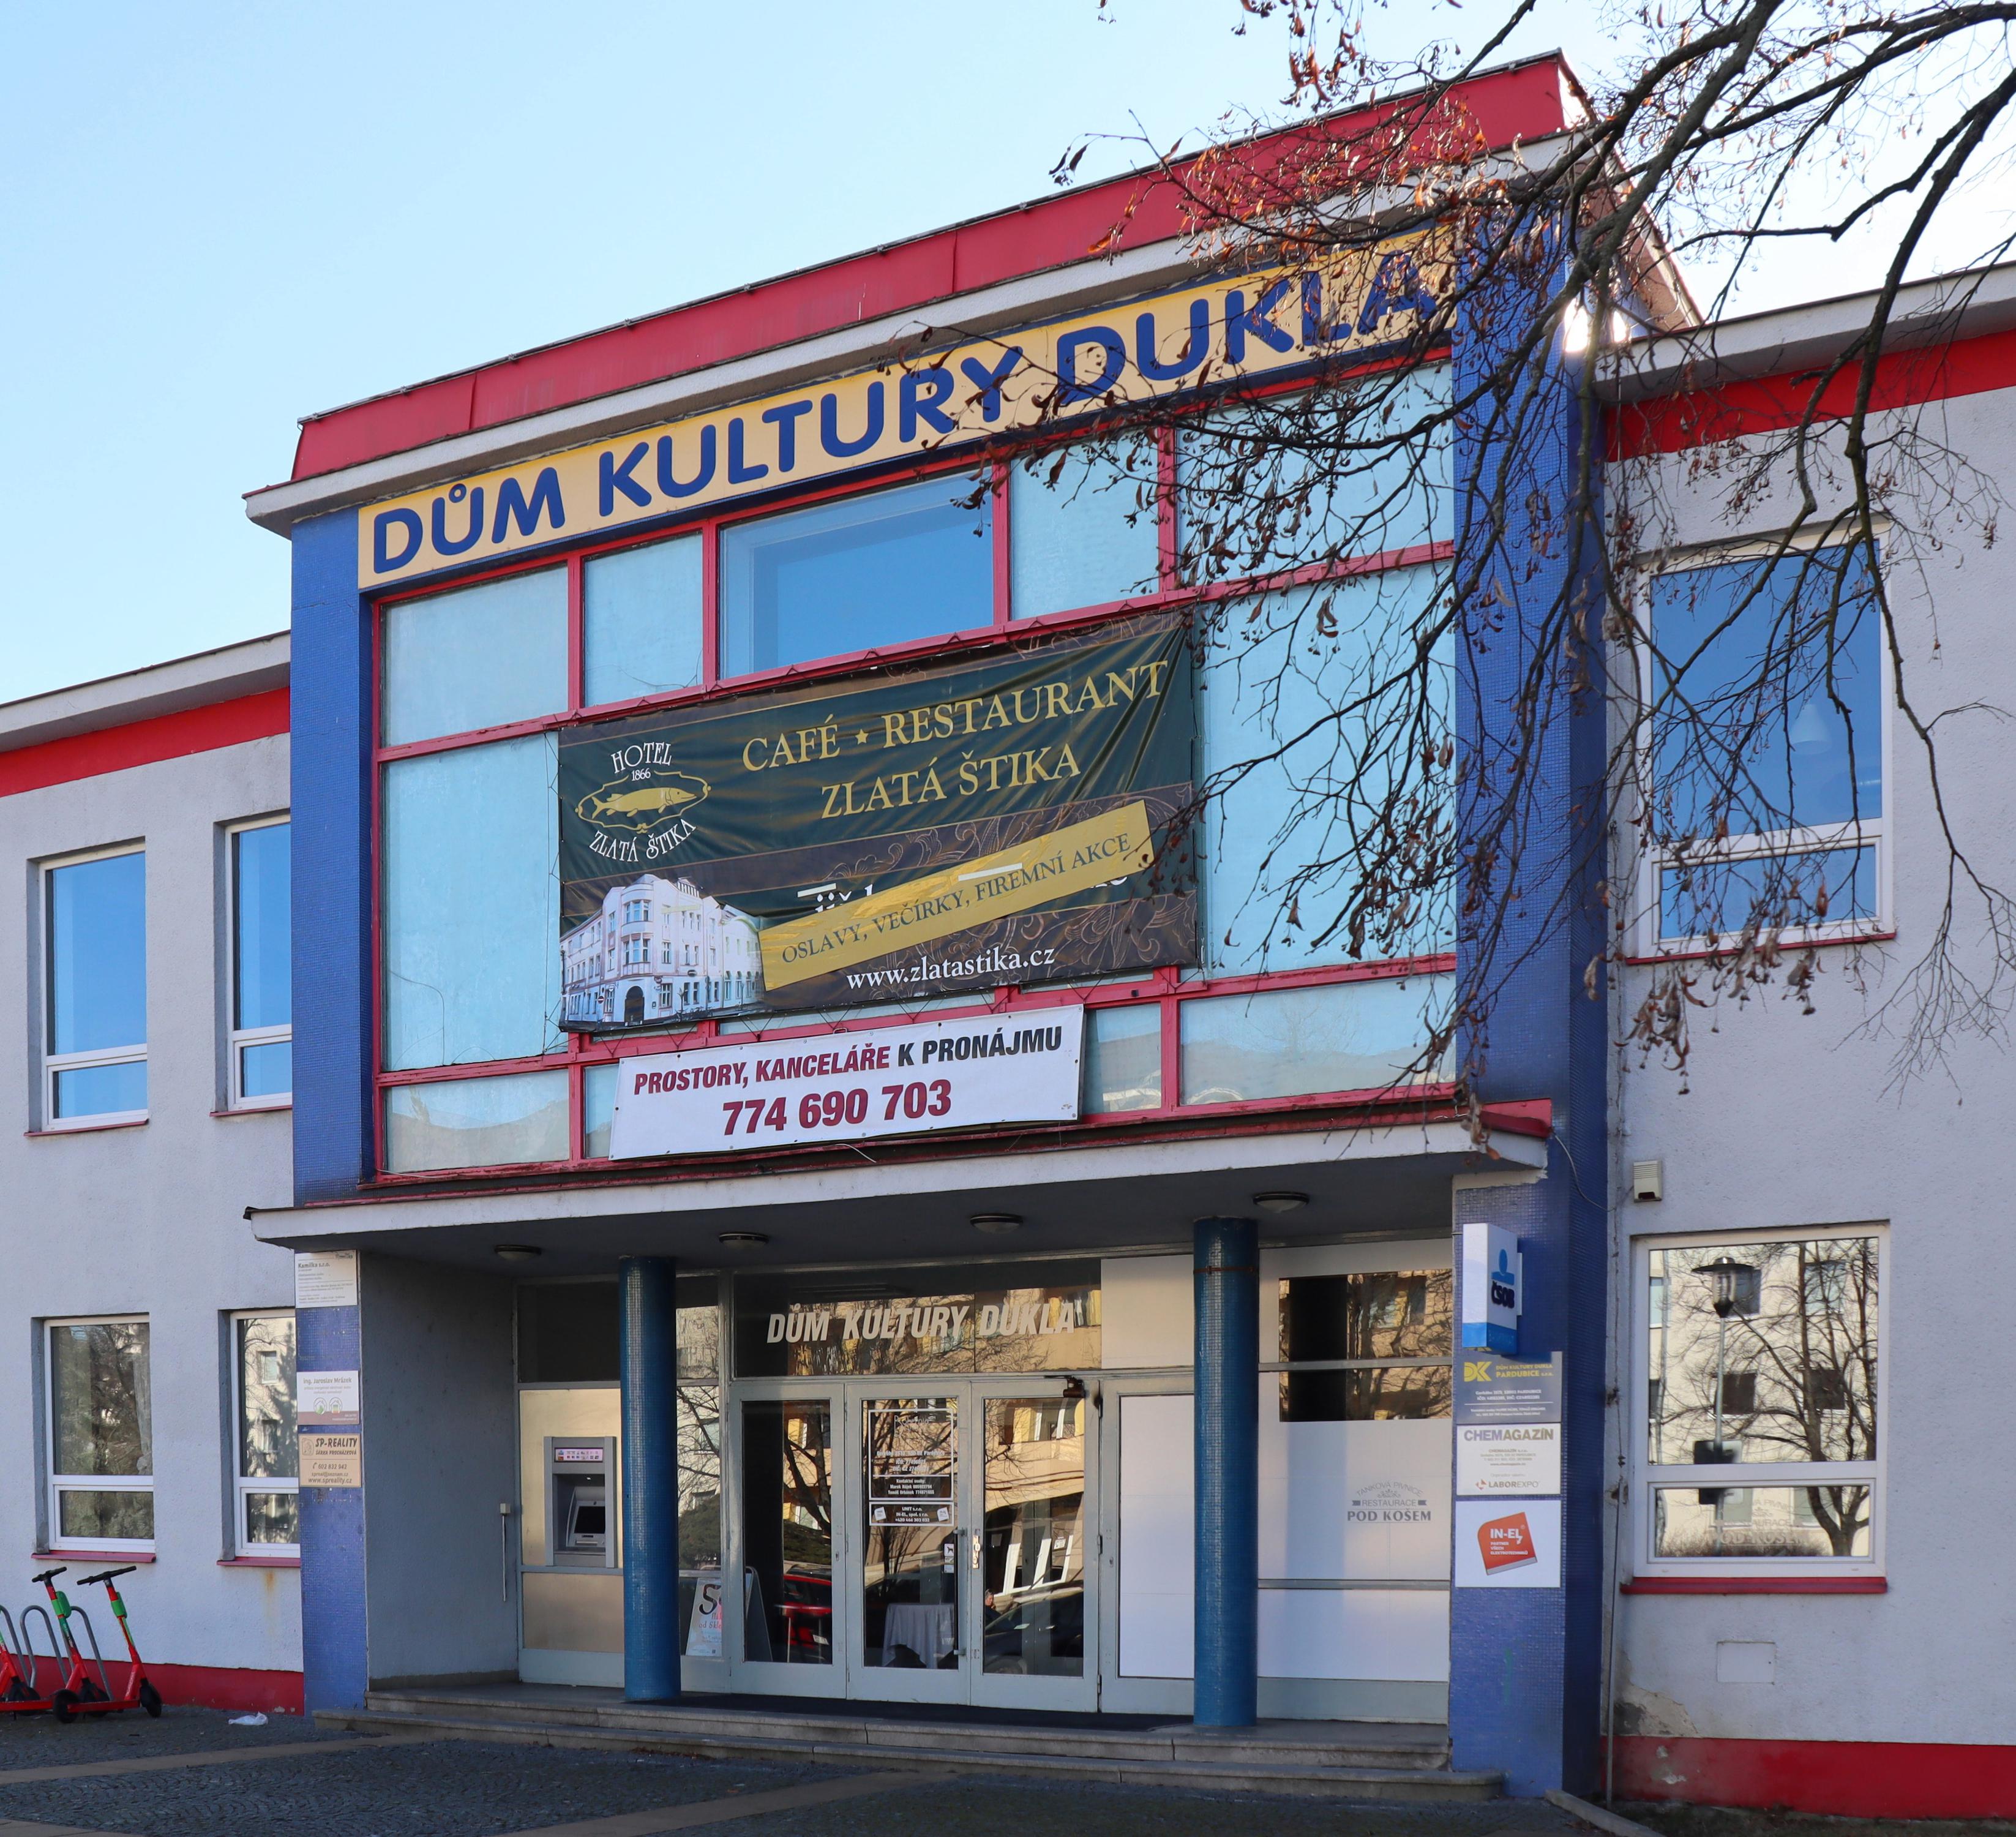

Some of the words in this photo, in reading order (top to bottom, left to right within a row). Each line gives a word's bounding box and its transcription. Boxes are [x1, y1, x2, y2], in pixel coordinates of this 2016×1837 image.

[373, 467, 566, 574] DŮM
[599, 345, 1023, 517] KULTURY
[1054, 250, 1437, 403] DUKLA
[742, 714, 841, 772] CAFÉ
[882, 660, 1168, 748] RESTAURANT
[611, 742, 672, 774] HOTEL
[631, 768, 651, 781] 1866
[820, 762, 947, 819] ZLATÁ
[958, 743, 1081, 796] ŠTIKA
[588, 830, 639, 862] ZLATÁ
[646, 818, 697, 859] ŠTIKA
[782, 923, 869, 964] OSLAVY,
[872, 890, 970, 935] VEČÍRKY,
[976, 851, 1063, 902] FIREMNÍ
[1071, 833, 1131, 871] AKCE
[847, 946, 1055, 991] www.zlatastika.cz
[634, 1061, 748, 1095] PROSTORY,
[755, 1042, 890, 1082] KANCELÁŘE
[897, 1042, 915, 1067] K
[922, 1026, 1062, 1064] PRONÁJMU
[722, 1097, 787, 1136] 774
[799, 1088, 868, 1129] 690
[882, 1079, 952, 1121] 703
[1491, 1280, 1515, 1309] ČSOB
[766, 1302, 830, 1343] DŮM
[842, 1305, 970, 1340] KULTURY
[979, 1302, 1075, 1336] DUKLA
[315, 1438, 358, 1448] SP-REALITY
[1464, 1428, 1554, 1441] CHEMAGAZÍN
[1356, 1481, 1391, 1498] TANKOVÁ
[1393, 1481, 1423, 1497] PIVNICE
[1347, 1511, 1377, 1521] POD
[1383, 1508, 1431, 1521] KOŠEM
[1490, 1528, 1523, 1542] IN-EL
